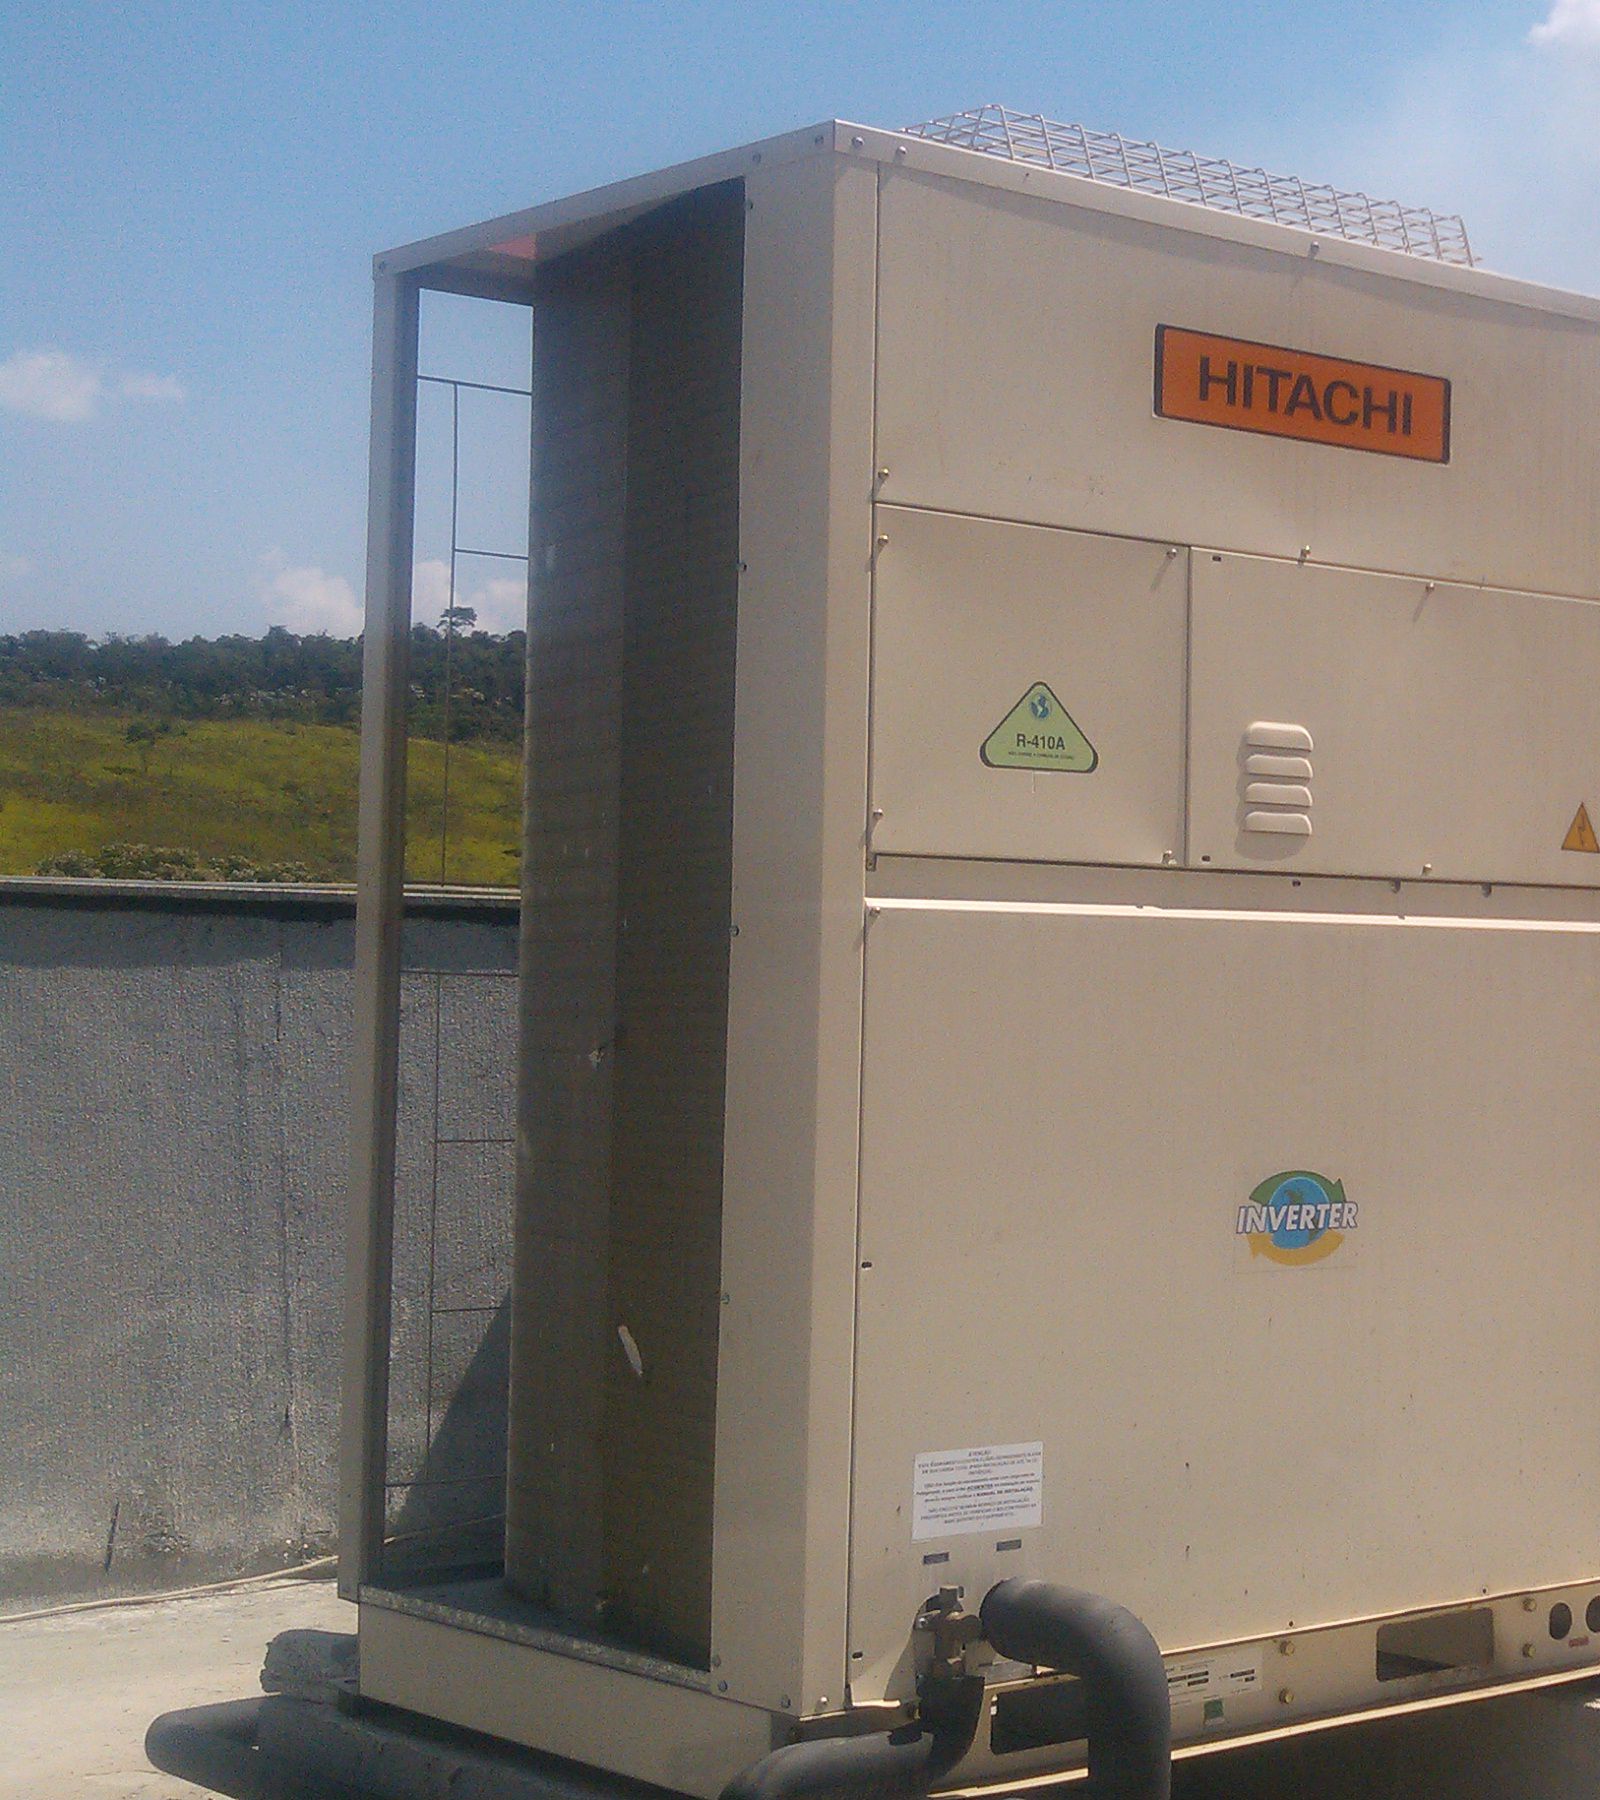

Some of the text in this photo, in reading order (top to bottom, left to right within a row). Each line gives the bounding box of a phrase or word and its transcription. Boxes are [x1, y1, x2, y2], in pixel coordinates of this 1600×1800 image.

[1199, 356, 1413, 436] HITACHI
[1016, 733, 1065, 750] R-410A
[1236, 1201, 1358, 1235] INVERTER
